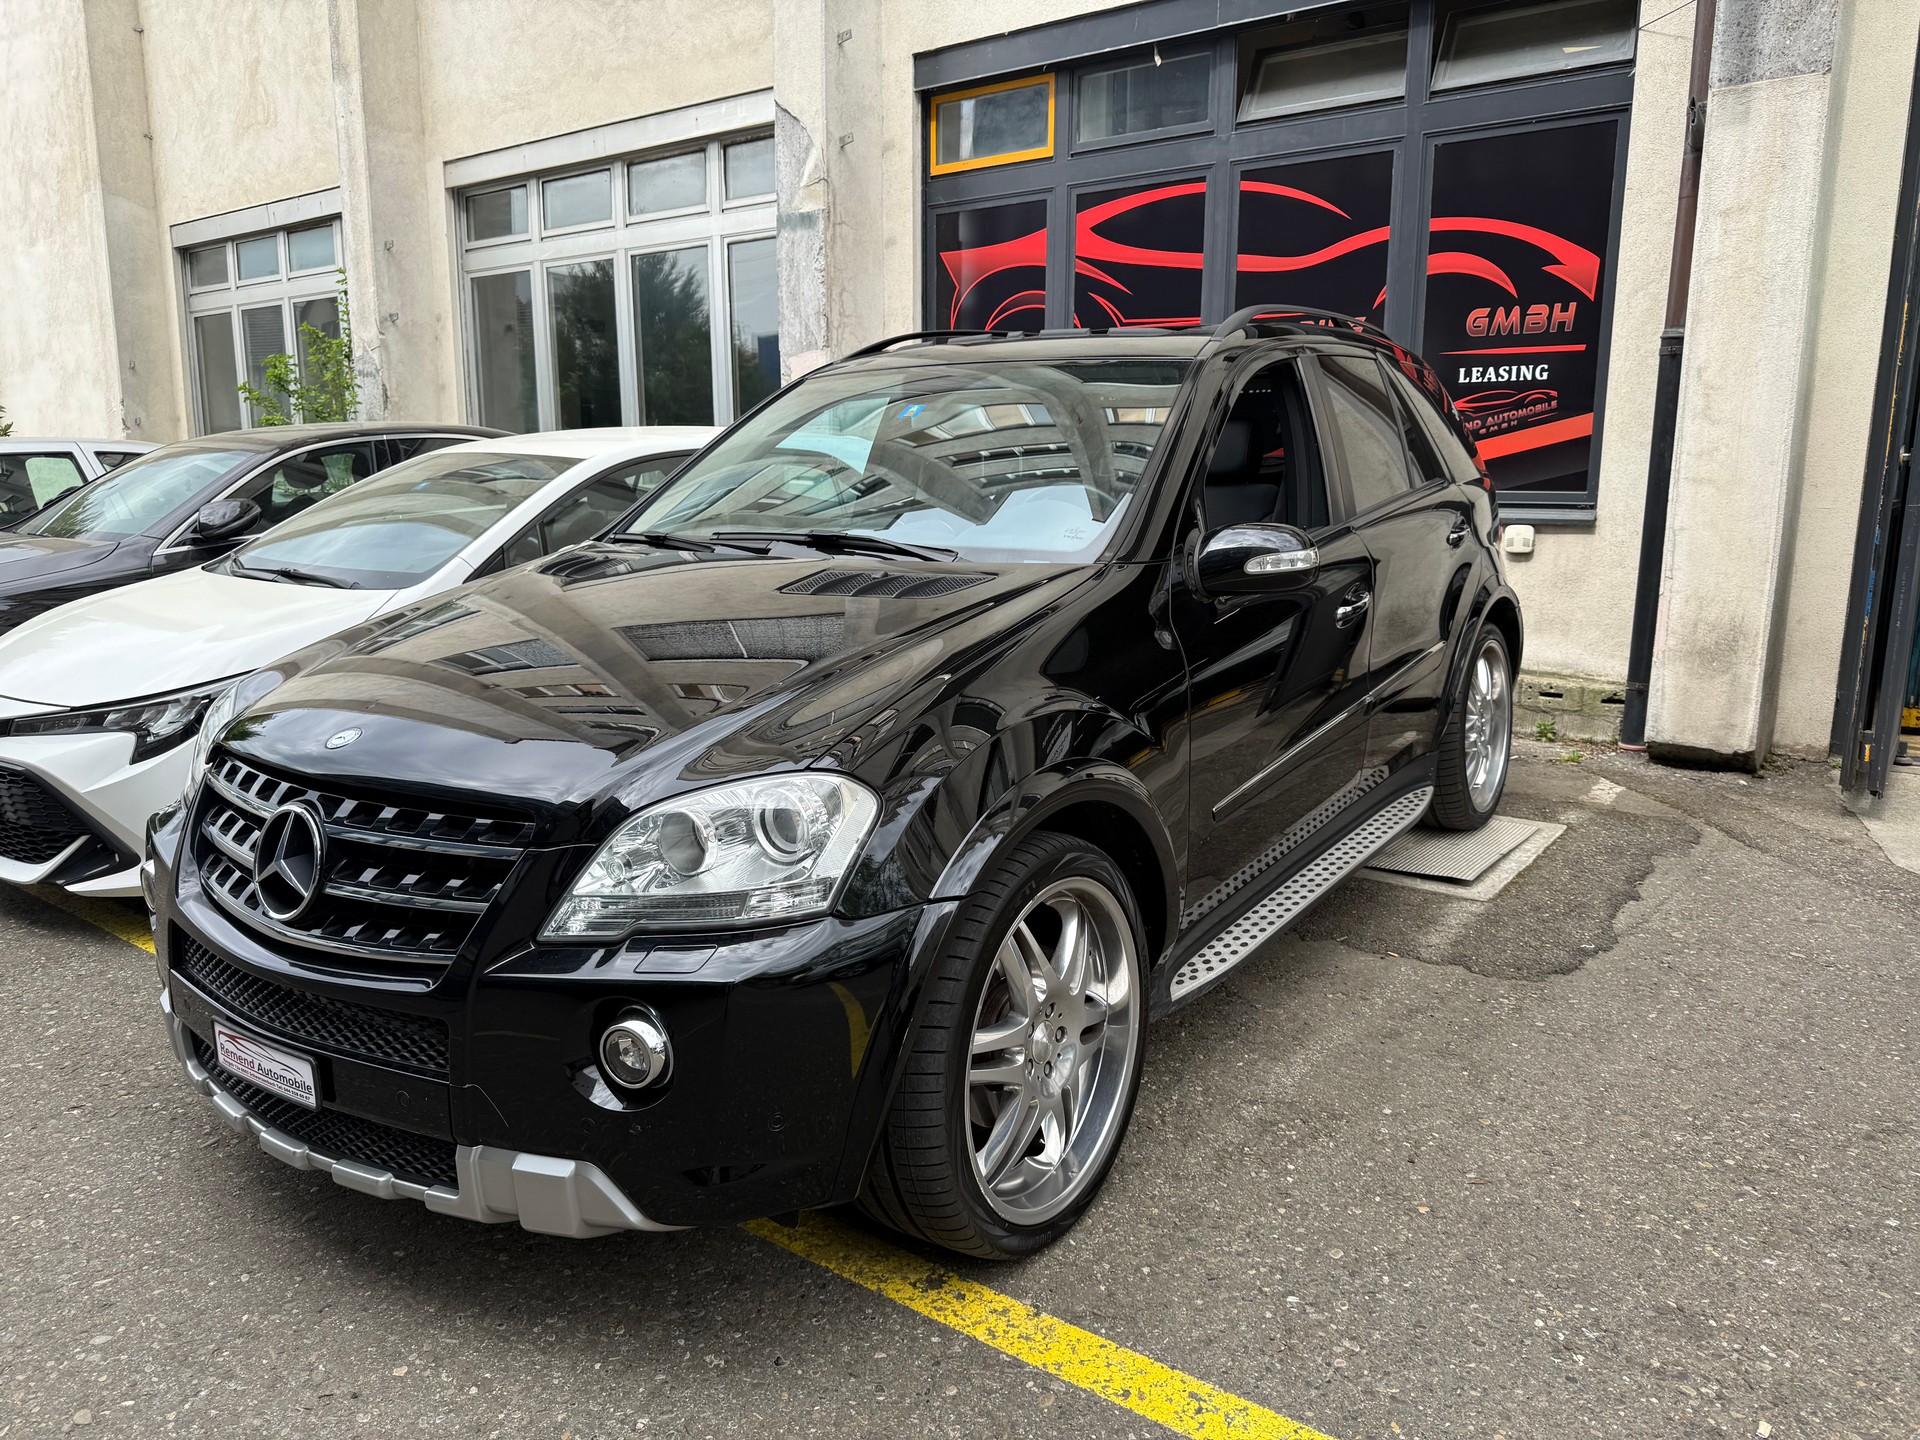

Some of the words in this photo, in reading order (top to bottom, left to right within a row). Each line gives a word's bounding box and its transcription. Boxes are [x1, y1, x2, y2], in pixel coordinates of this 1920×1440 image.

[1466, 302, 1577, 337] GMBH
[1458, 364, 1549, 384] LEASING
[1485, 400, 1558, 427] AUTOMOBILE
[220, 1042, 255, 1069] Remend
[257, 1062, 313, 1094] Automobile
